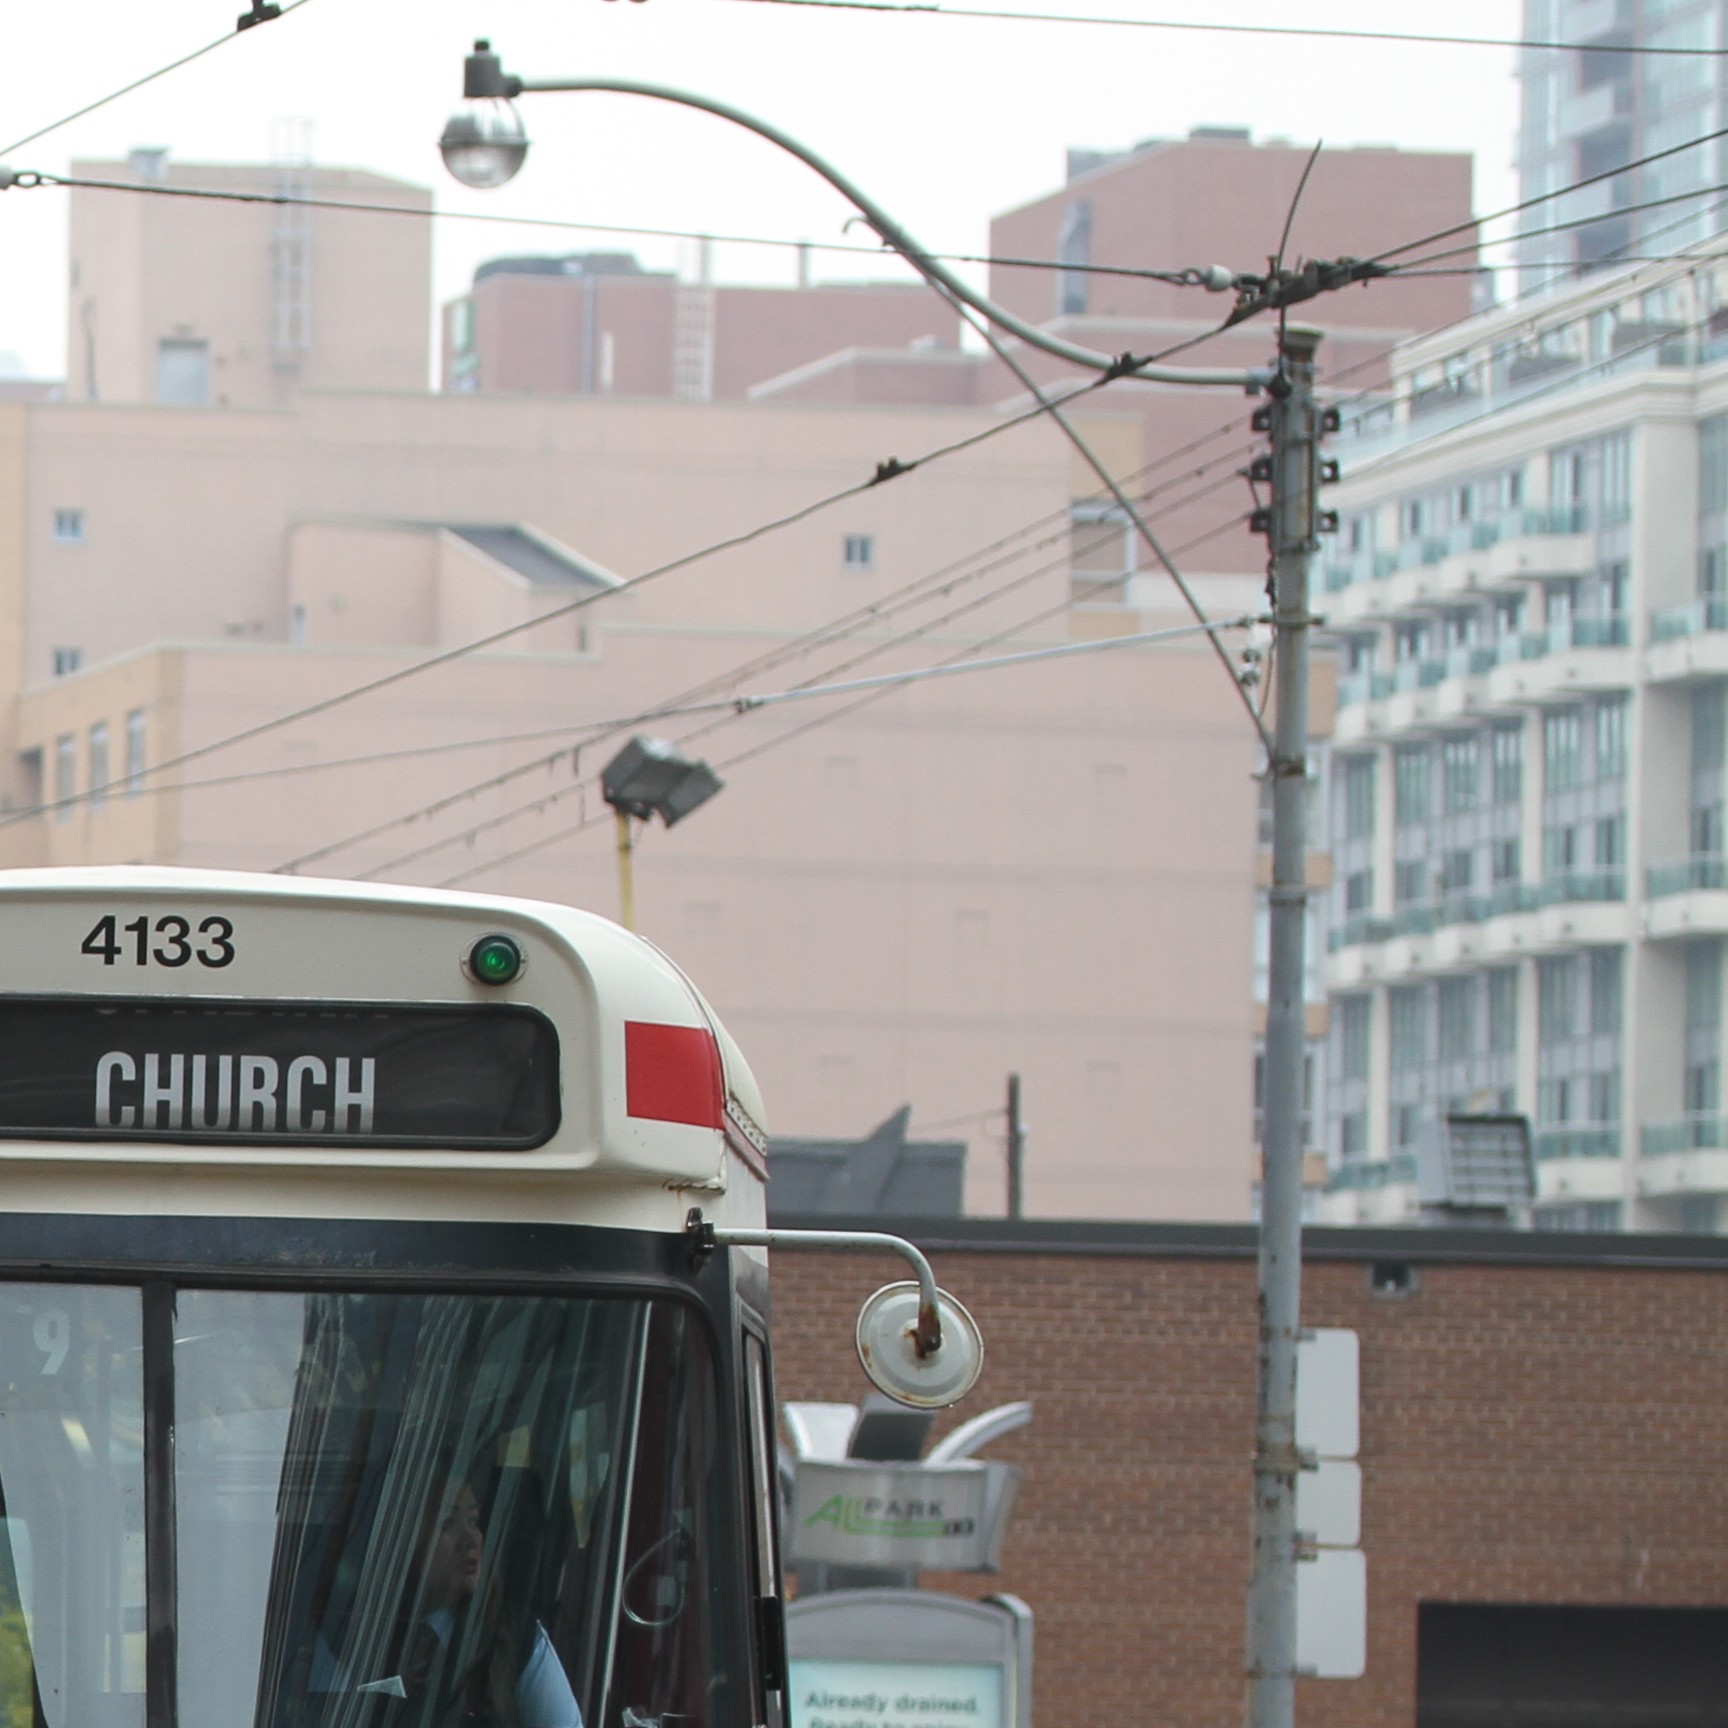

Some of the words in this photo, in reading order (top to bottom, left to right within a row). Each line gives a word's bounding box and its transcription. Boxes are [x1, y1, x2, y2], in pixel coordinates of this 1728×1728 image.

[79, 914, 236, 968] 4133
[94, 1050, 376, 1136] CHURCH
[808, 1690, 887, 1715] Already
